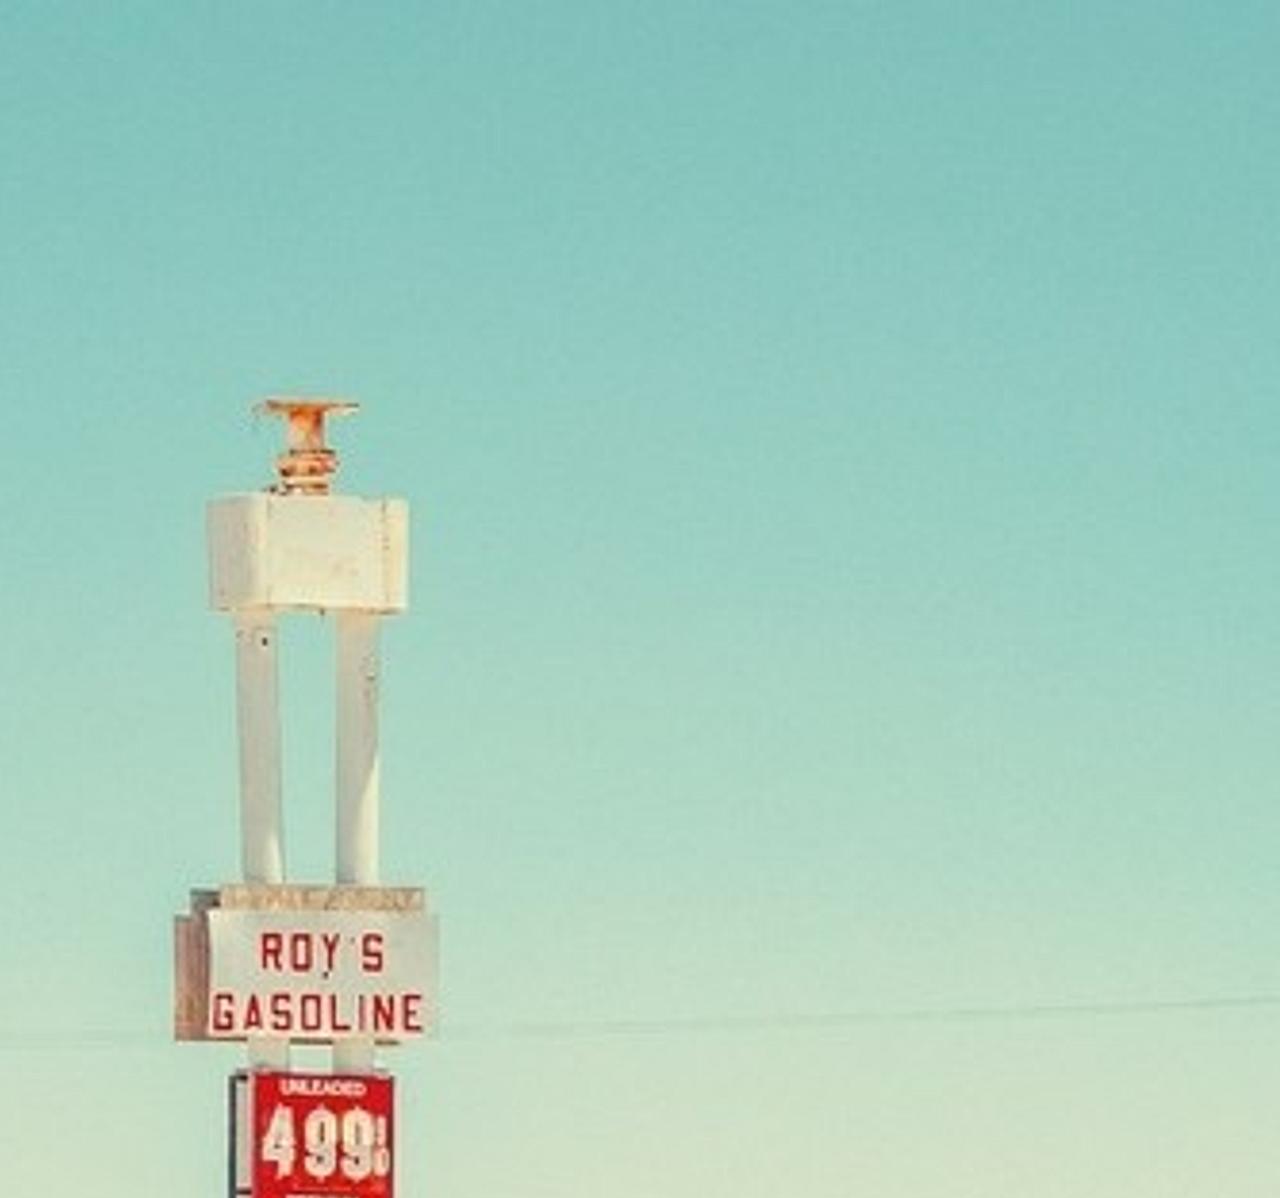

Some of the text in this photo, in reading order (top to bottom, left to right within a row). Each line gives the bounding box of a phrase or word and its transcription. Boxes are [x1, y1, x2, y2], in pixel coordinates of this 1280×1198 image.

[261, 932, 384, 973] ROY'S
[212, 993, 424, 1032] GASOLINE
[280, 1078, 368, 1097] UNLEADED
